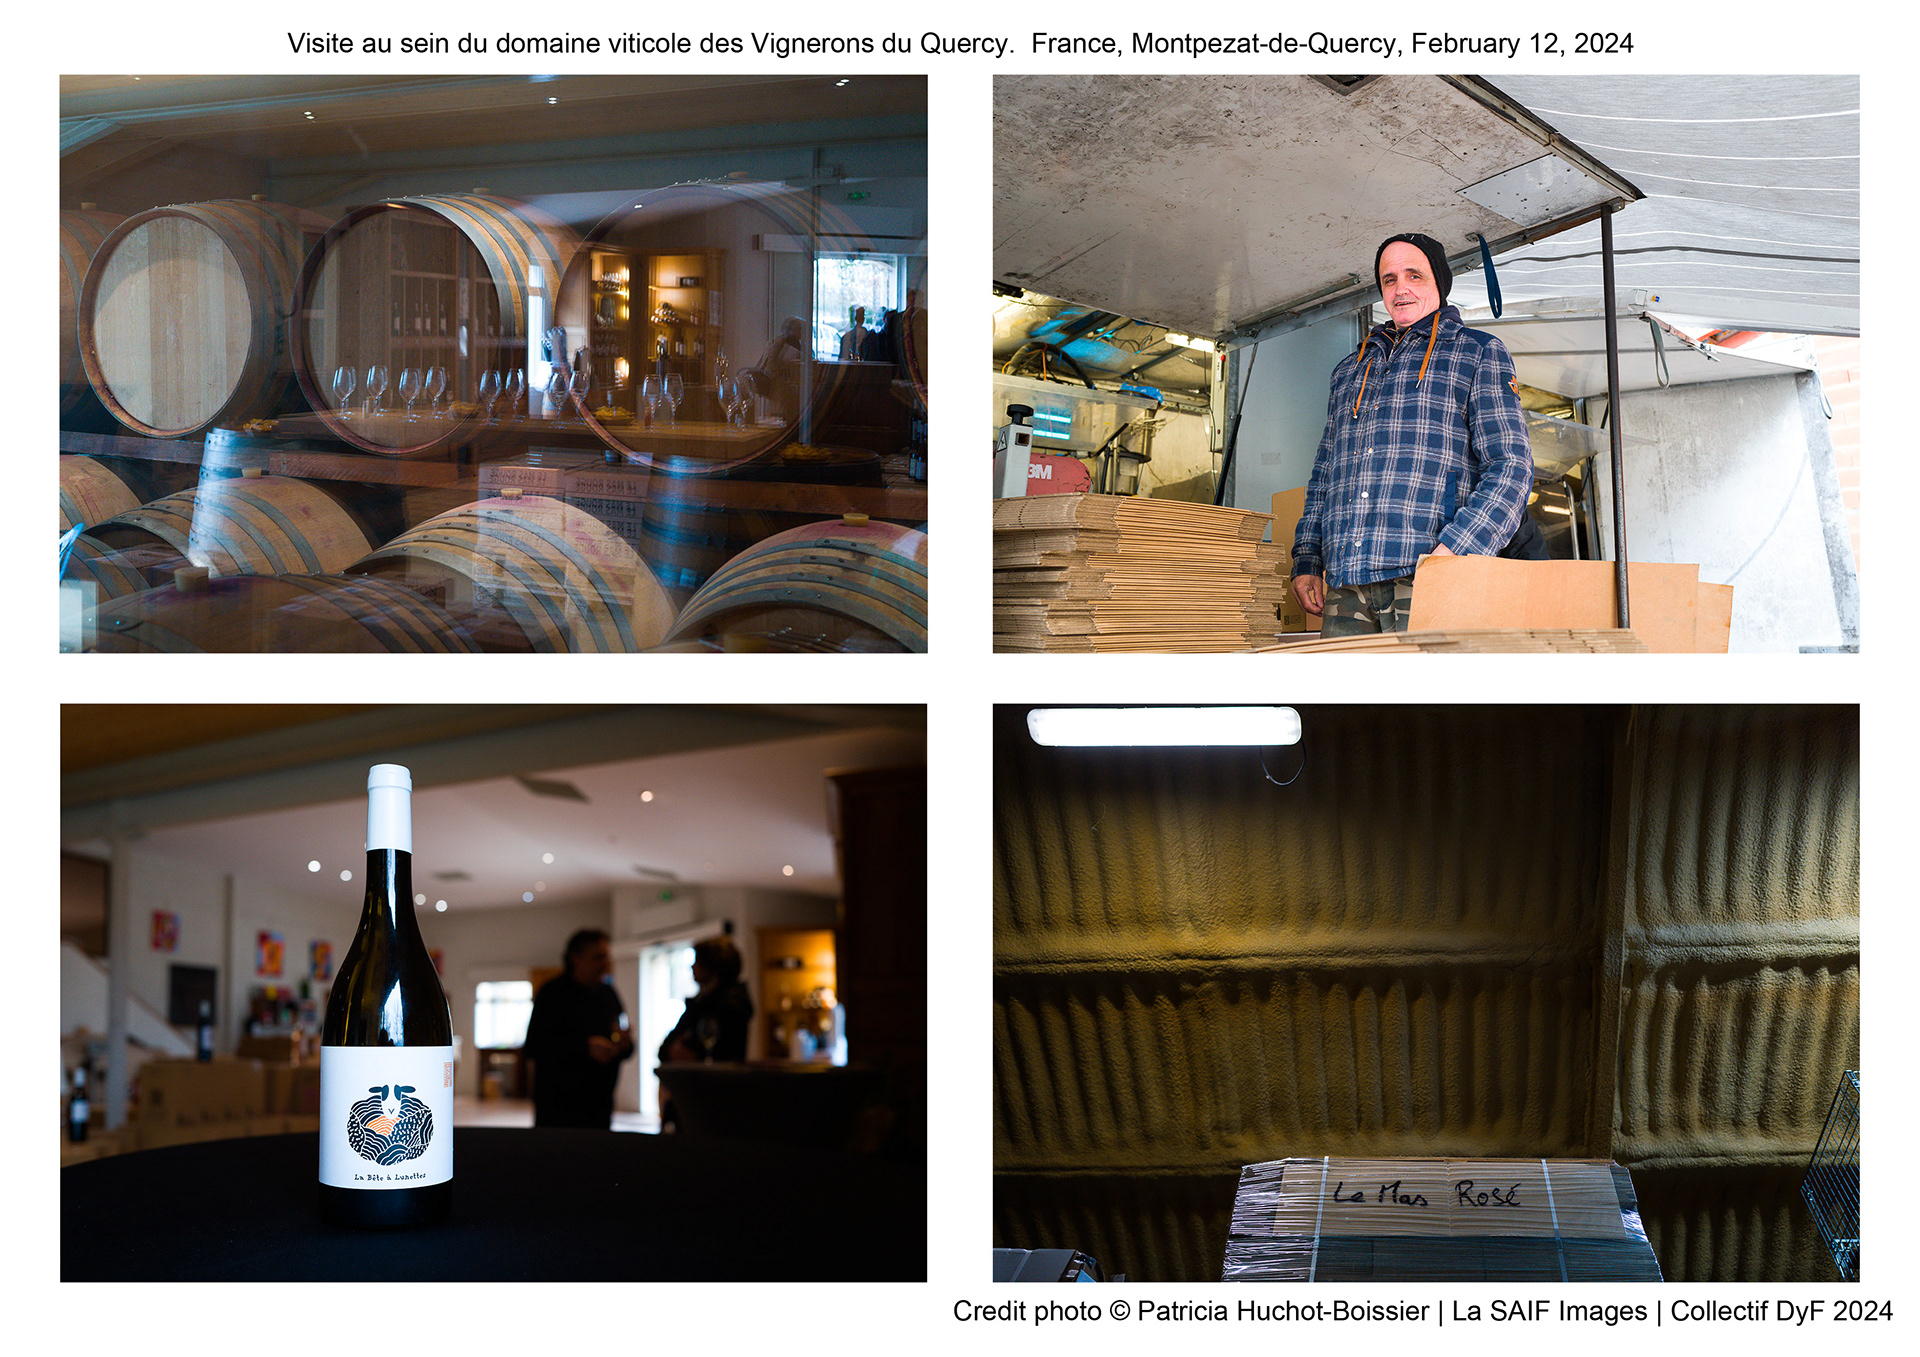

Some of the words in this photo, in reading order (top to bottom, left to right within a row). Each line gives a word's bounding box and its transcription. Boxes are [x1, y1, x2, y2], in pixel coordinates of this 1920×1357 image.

[1028, 463, 1052, 480] 3M
[354, 1173, 365, 1181] La
[367, 1173, 384, 1182] Bête
[395, 1172, 427, 1181] Lunettes
[1333, 1181, 1366, 1203] Le
[1378, 1180, 1429, 1207] Mas
[1454, 1179, 1522, 1207] Rosé
